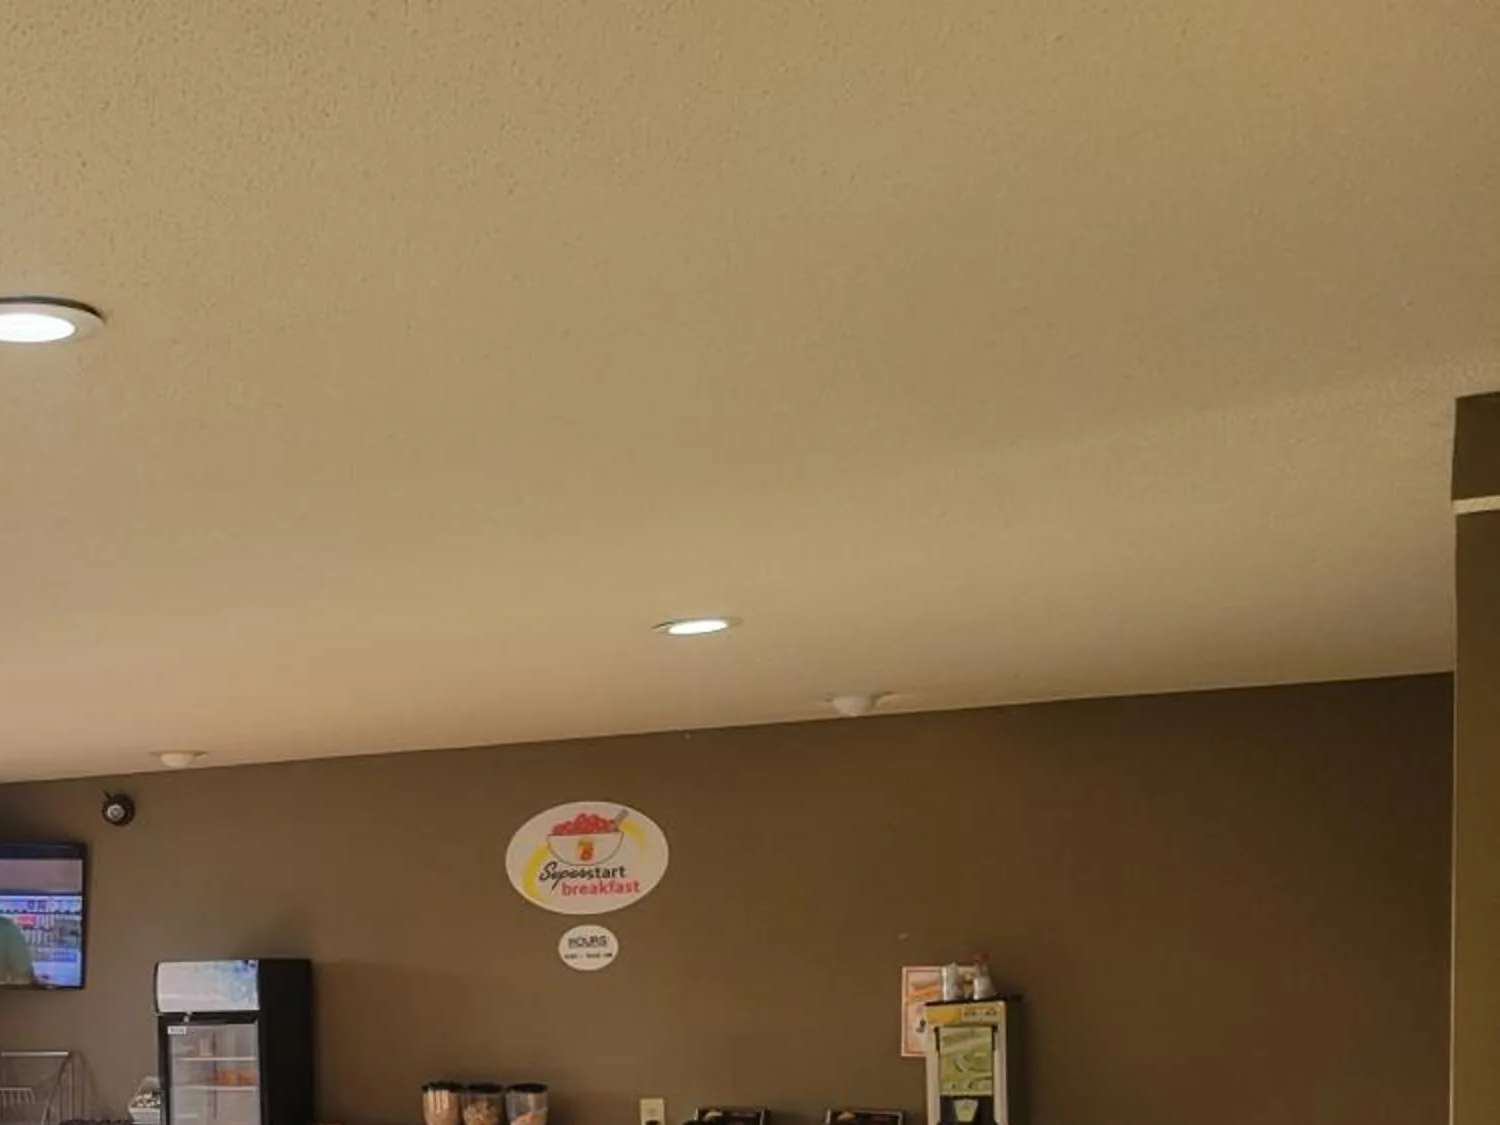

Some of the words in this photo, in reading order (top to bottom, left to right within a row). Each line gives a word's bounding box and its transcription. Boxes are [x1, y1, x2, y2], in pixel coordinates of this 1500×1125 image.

[539, 861, 626, 891] Superstart
[562, 880, 641, 896] breakfast
[568, 935, 608, 949] HOURS
